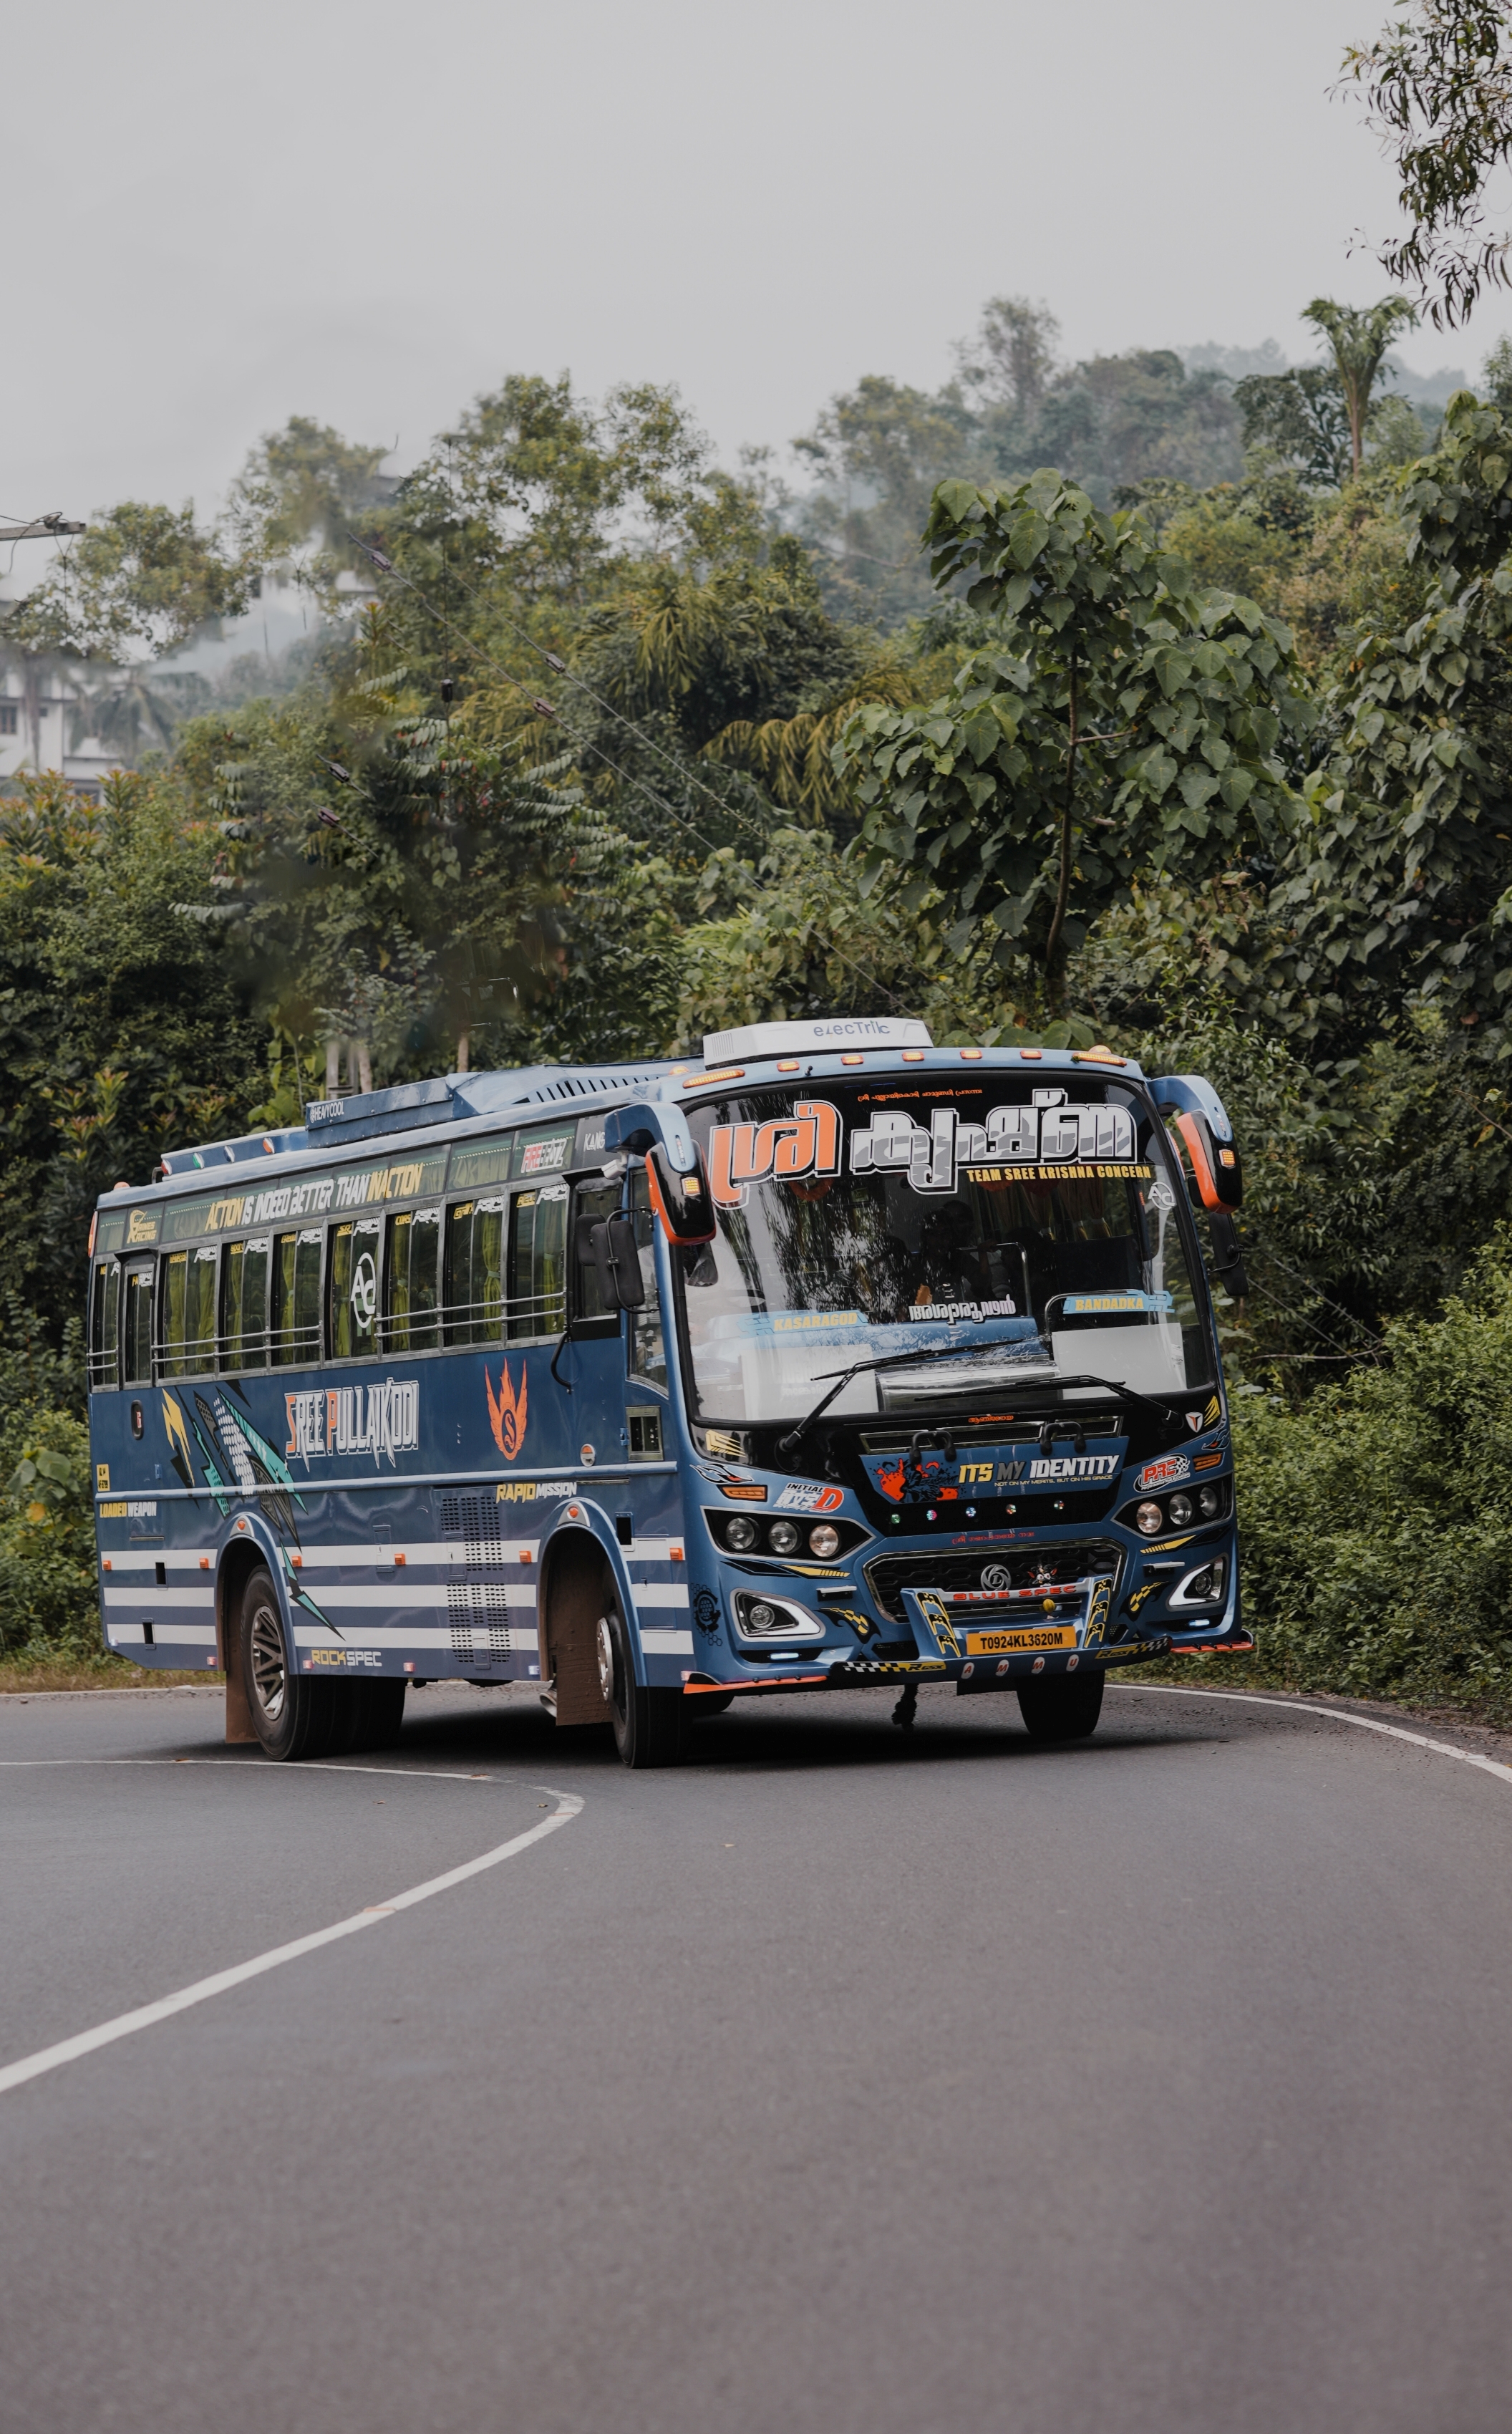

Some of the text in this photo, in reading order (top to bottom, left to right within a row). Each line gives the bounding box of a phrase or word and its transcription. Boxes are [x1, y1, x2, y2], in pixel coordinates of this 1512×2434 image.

[709, 1088, 1138, 1210] ശ്രീ കൃഷ്ണ
[966, 1165, 1151, 1182] TEAM SREE KRISHNA CONCERN
[205, 1162, 424, 1231] ACTION IS INDEED BETTER THAN INACTION
[1075, 1297, 1144, 1311] BANDADKA
[774, 1312, 858, 1331] KASARAGOD
[284, 1377, 420, 1471] SREE PULLAIKODI
[958, 1462, 994, 1484] ITS
[997, 1460, 1026, 1481] MY
[1029, 1455, 1120, 1479] IDENTITY
[1143, 1459, 1178, 1483] PRC
[495, 1482, 577, 1504] RAPID MISSION
[787, 1483, 844, 1513] INITIAL D
[100, 1502, 158, 1518] LOADED WEAPON
[954, 1585, 1077, 1601] BLUE SPEC
[980, 1632, 1063, 1650] T0924KL3620M
[311, 1649, 382, 1666] ROCK SPEC
